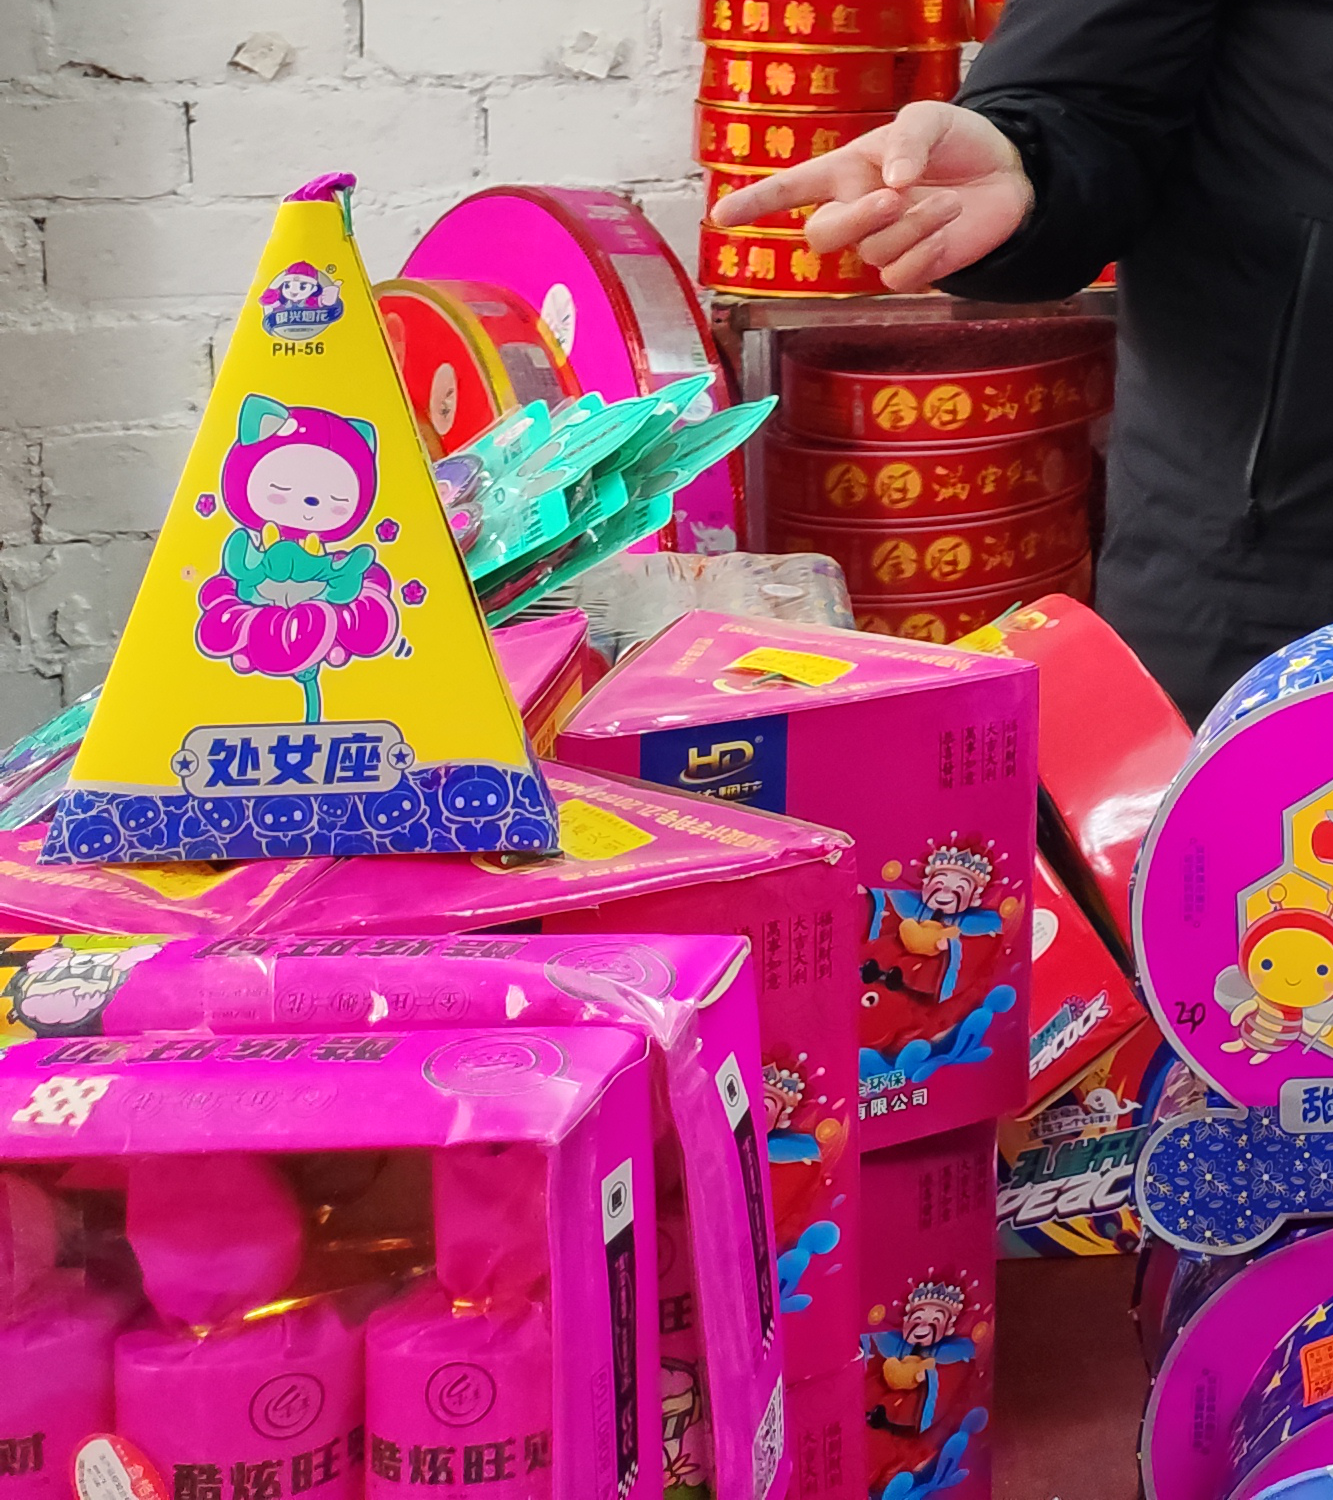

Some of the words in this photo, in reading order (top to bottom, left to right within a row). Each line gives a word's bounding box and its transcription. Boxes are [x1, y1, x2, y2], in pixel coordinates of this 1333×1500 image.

[272, 342, 325, 357] PH-56
[206, 732, 383, 789] 处女座
[1010, 1125, 1147, 1190] 孔雀开
[172, 1425, 364, 1500] 酷炫旺
